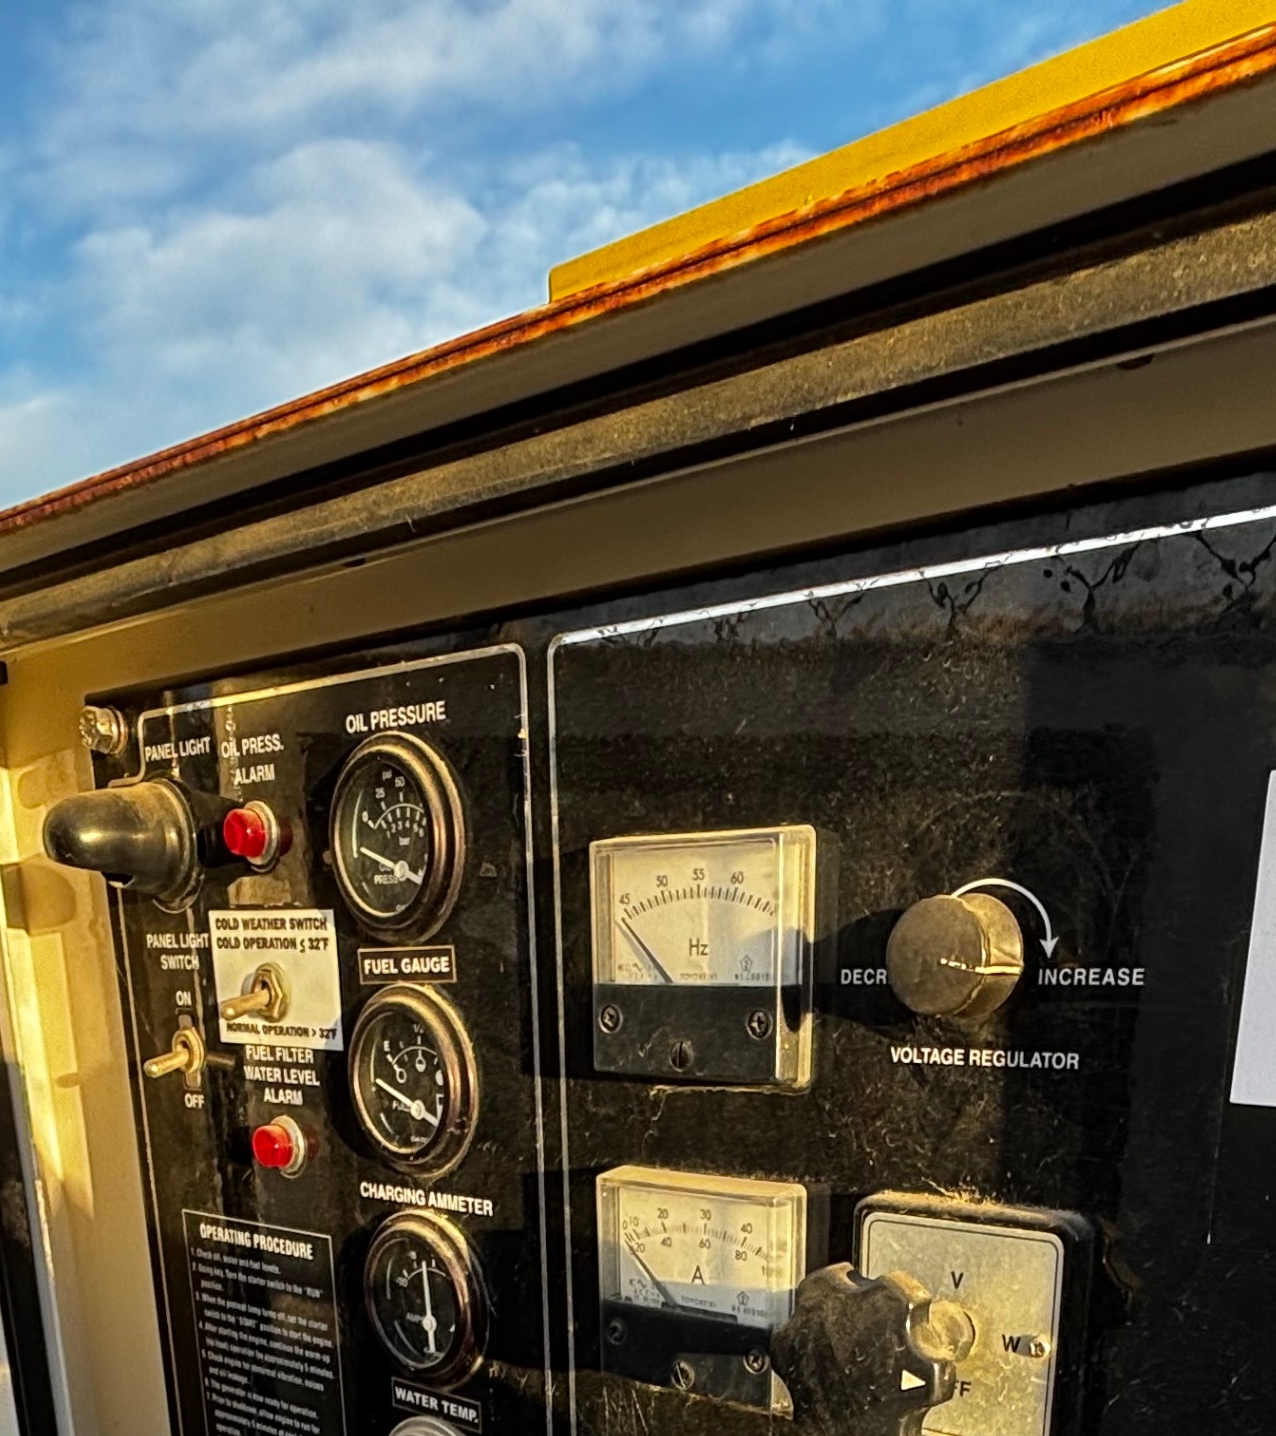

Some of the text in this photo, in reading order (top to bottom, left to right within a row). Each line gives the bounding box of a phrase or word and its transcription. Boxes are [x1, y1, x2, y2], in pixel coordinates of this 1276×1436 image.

[346, 701, 446, 734] OIL PRESSURE
[145, 737, 211, 762] PANEL LIGHT
[222, 734, 284, 758] OIL PRESS.
[234, 764, 275, 785] ALARM
[362, 776, 405, 822] 0 25 50
[391, 824, 397, 833] 2
[397, 821, 403, 830] 3
[404, 819, 410, 828] 4
[619, 868, 745, 905] 45 50 55 60
[216, 917, 328, 931] COLD WEATHER SWITCH
[146, 933, 209, 948] PANEL LIGHT
[217, 937, 240, 949] COLD
[243, 937, 297, 950] OPERATION
[689, 938, 709, 957] Hz
[160, 955, 199, 970] SWITCH
[364, 956, 451, 975] FUEL GAUGE
[841, 968, 1145, 986] DECR INCREASE
[176, 991, 192, 1006] ON
[226, 1022, 261, 1035] NORMAL
[262, 1024, 309, 1038] OPERATION
[245, 1045, 314, 1064] FUEL FILTER
[891, 1046, 1079, 1070] VOLTAGE REGULATOR
[244, 1066, 320, 1086] WATER LEVEL
[184, 1093, 204, 1108] OFF
[263, 1088, 303, 1106] ALARM
[360, 1182, 494, 1217] CHARGING AMMETER
[657, 1208, 669, 1219] 20
[700, 1209, 712, 1221] 30
[741, 1223, 753, 1234] 40
[199, 1223, 314, 1260] OPERATING PROCEDURE
[661, 1237, 672, 1248] 40
[699, 1238, 711, 1249] 60
[735, 1250, 747, 1262] 80
[691, 1265, 706, 1285] A
[951, 1271, 964, 1289] V
[1002, 1334, 1021, 1353] W
[395, 1386, 479, 1423] WATER TEMP.
